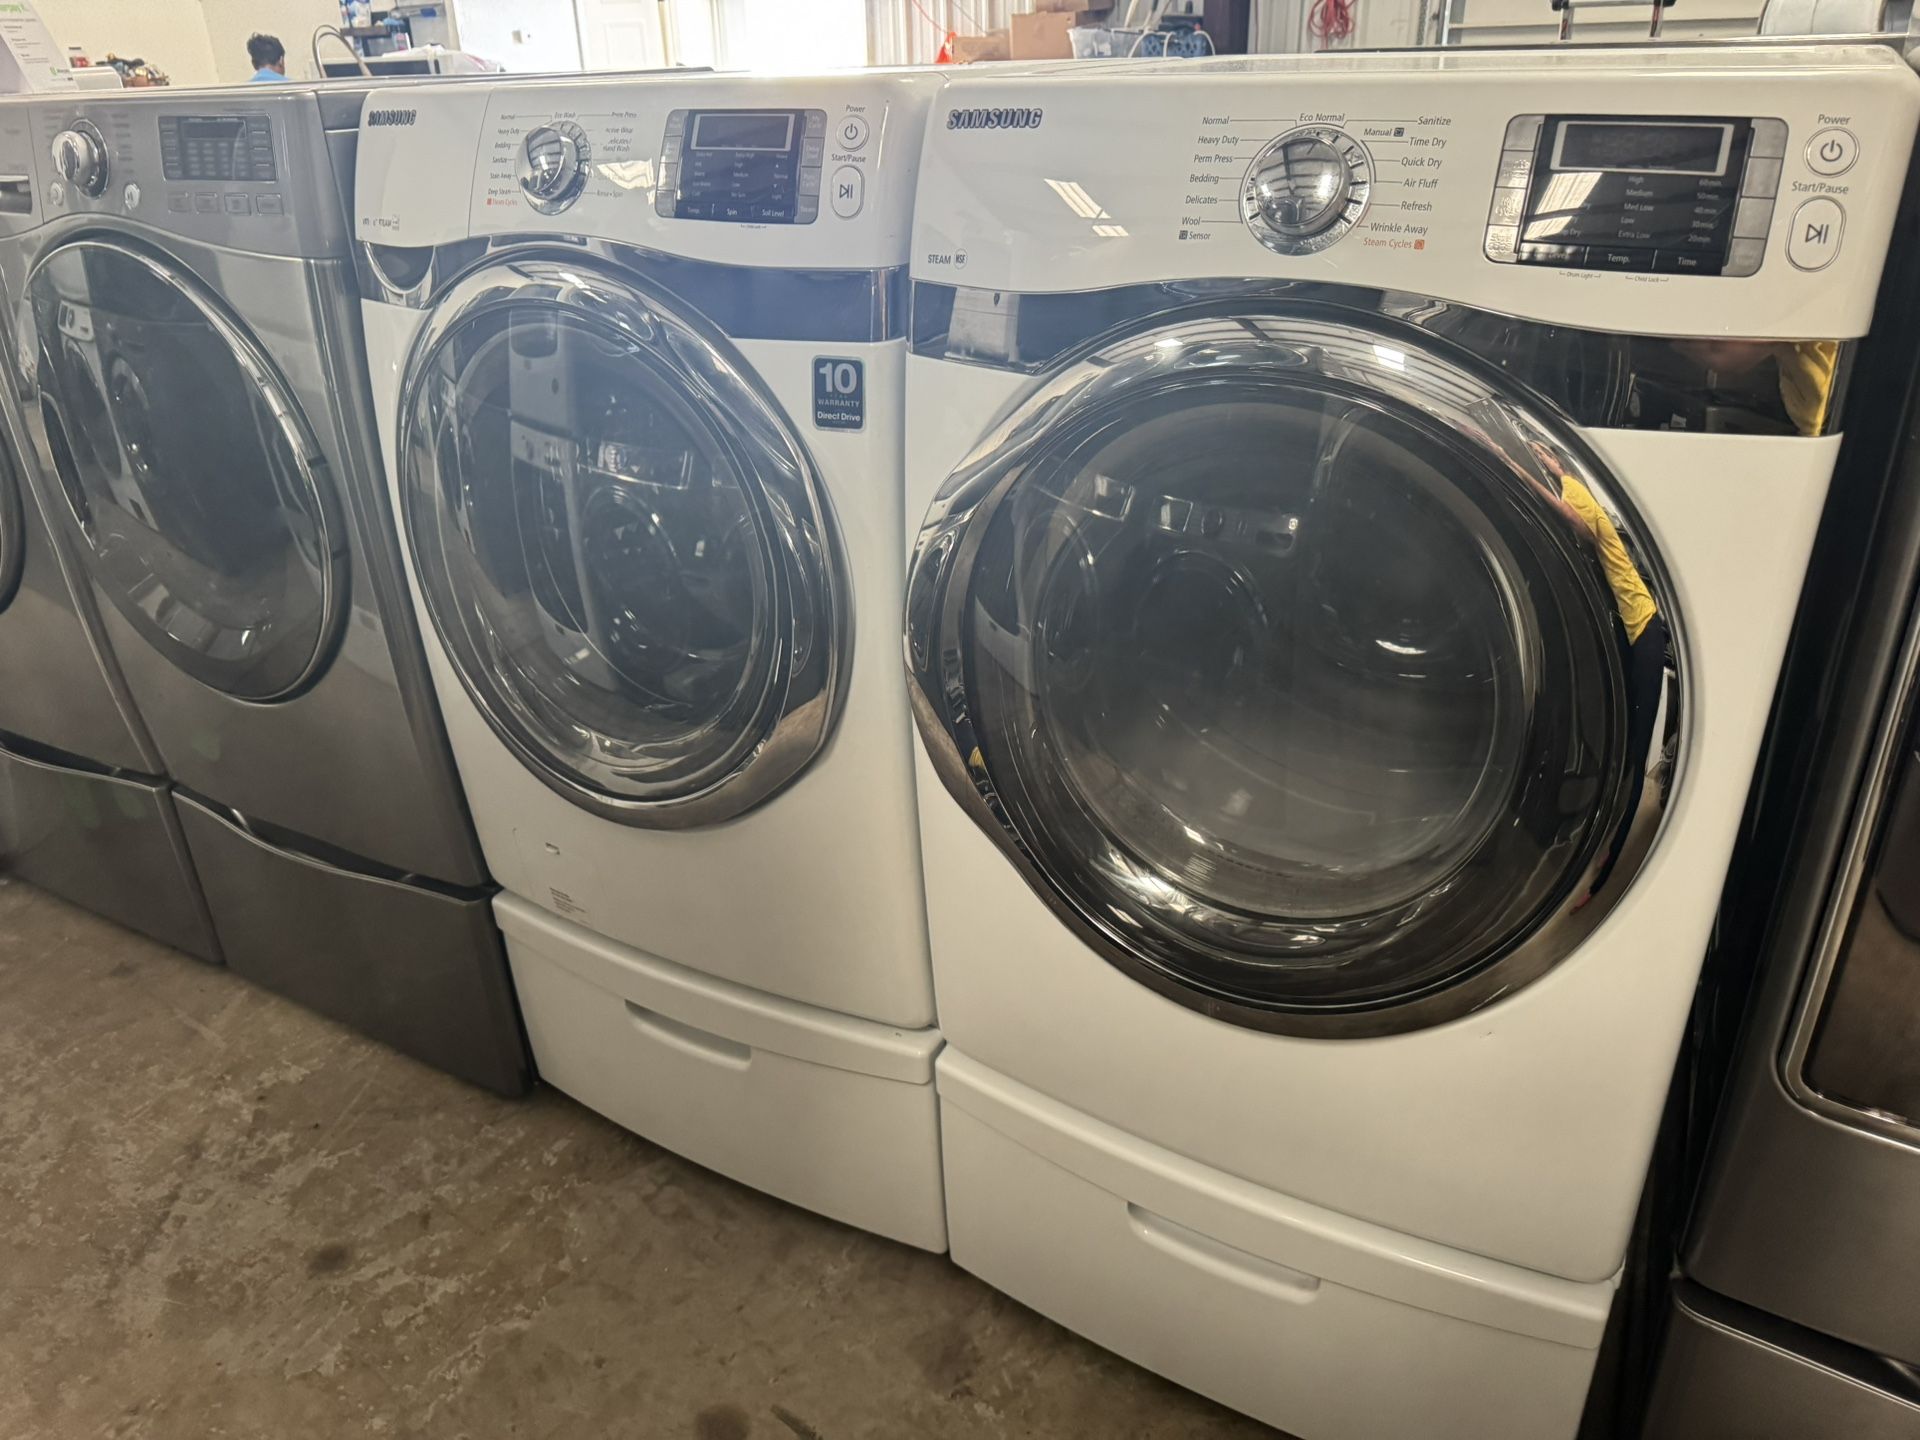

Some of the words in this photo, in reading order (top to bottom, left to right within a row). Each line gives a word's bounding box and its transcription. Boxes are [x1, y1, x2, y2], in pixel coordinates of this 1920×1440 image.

[368, 109, 417, 127] SAMSUNG
[946, 108, 1043, 130] SAMSUNG
[1202, 116, 1230, 125] Normal
[1299, 113, 1313, 121] Eco
[1315, 113, 1345, 122] Normal
[1418, 116, 1451, 126] Sanitize
[1818, 114, 1850, 124] Power
[1363, 128, 1392, 136] Manual
[1198, 136, 1220, 146] Heavy
[1222, 136, 1239, 146] Duty
[1408, 137, 1430, 146] Time
[1431, 137, 1447, 148] Dry
[832, 154, 866, 163] Start/Pause
[1194, 155, 1212, 163] Perm
[1214, 154, 1233, 163] Press
[1401, 157, 1425, 166] Quick
[1427, 158, 1443, 169] Dry
[1190, 174, 1219, 184] Bedding
[1403, 179, 1416, 187] Air
[1418, 178, 1439, 188] Fluff
[1792, 181, 1849, 194] Start/Pause
[1185, 195, 1218, 204] Delicates
[1401, 201, 1432, 211] Refresh
[1624, 203, 1638, 211] Med
[1640, 204, 1654, 212] Low
[726, 208, 737, 216] Spin
[1182, 217, 1201, 225] Wool
[1370, 223, 1402, 232] Wrinkle
[1403, 224, 1428, 236] Away
[1188, 231, 1211, 240] Sensor
[1363, 238, 1387, 246] Steam
[1388, 239, 1412, 249] Cycles
[928, 254, 951, 264] STEAM
[1608, 254, 1630, 263] Temp.
[1678, 257, 1697, 266] Time
[819, 362, 857, 394] 10
[817, 398, 860, 408] WARRANTY
[817, 411, 839, 420] Direct
[841, 413, 860, 422] Drive
